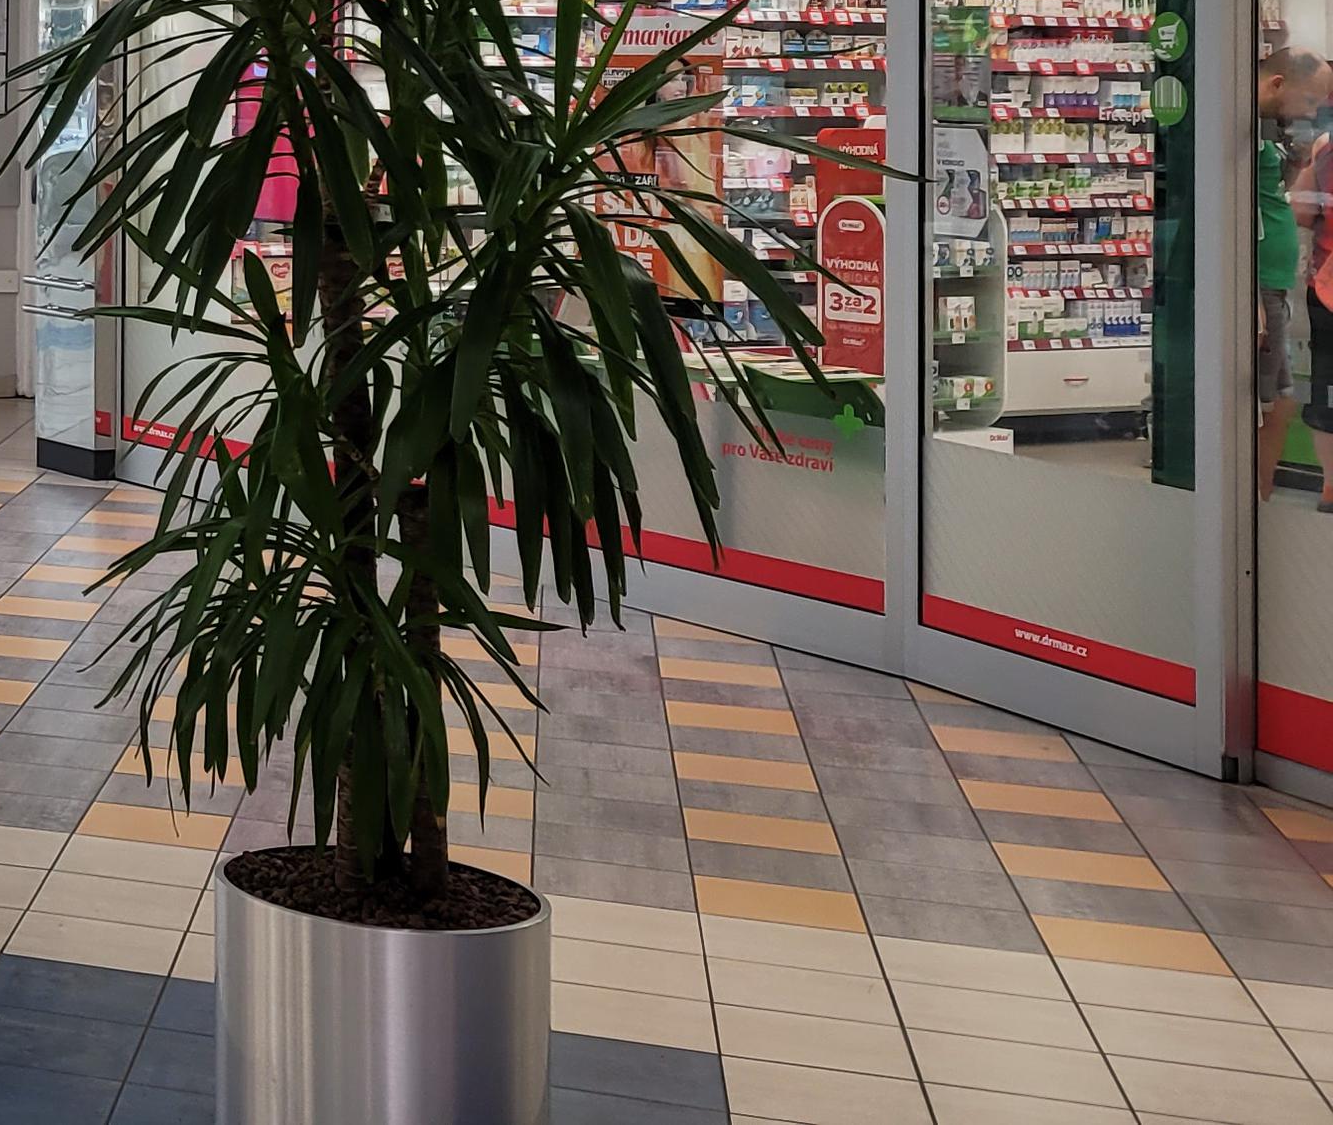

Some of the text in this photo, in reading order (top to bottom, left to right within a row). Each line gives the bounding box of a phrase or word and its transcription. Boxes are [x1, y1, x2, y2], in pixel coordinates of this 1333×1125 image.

[826, 257, 880, 273] VÝHODNÁ
[829, 292, 878, 315] 3 za 2
[1014, 626, 1088, 659] www.drmax.cz
